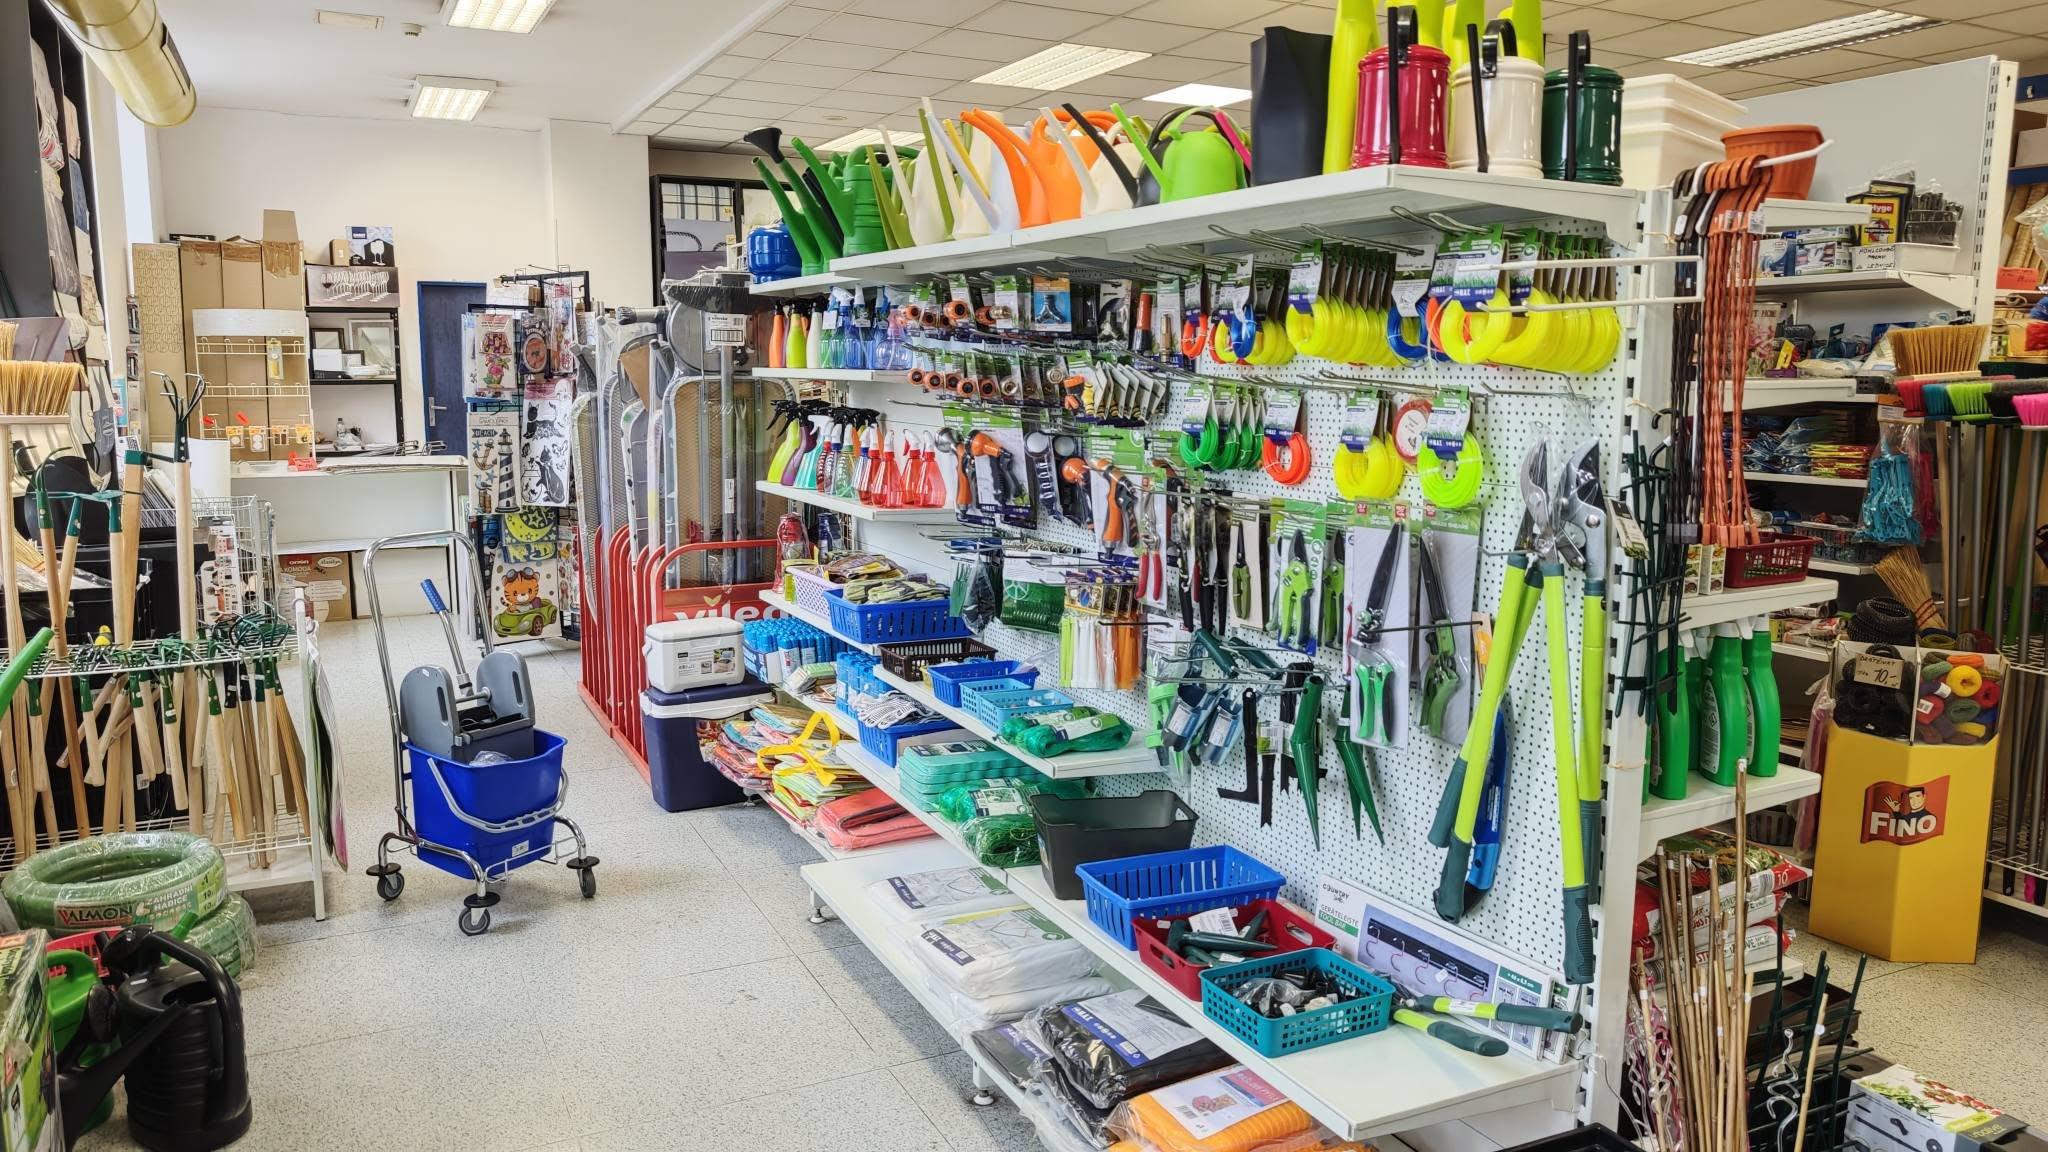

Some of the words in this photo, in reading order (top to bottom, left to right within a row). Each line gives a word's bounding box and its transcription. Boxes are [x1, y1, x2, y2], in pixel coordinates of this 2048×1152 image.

[1869, 811, 1937, 838] FINO
[1322, 883, 1350, 899] COUNTRY
[154, 894, 188, 911] HADICE
[58, 904, 133, 925] VALMON
